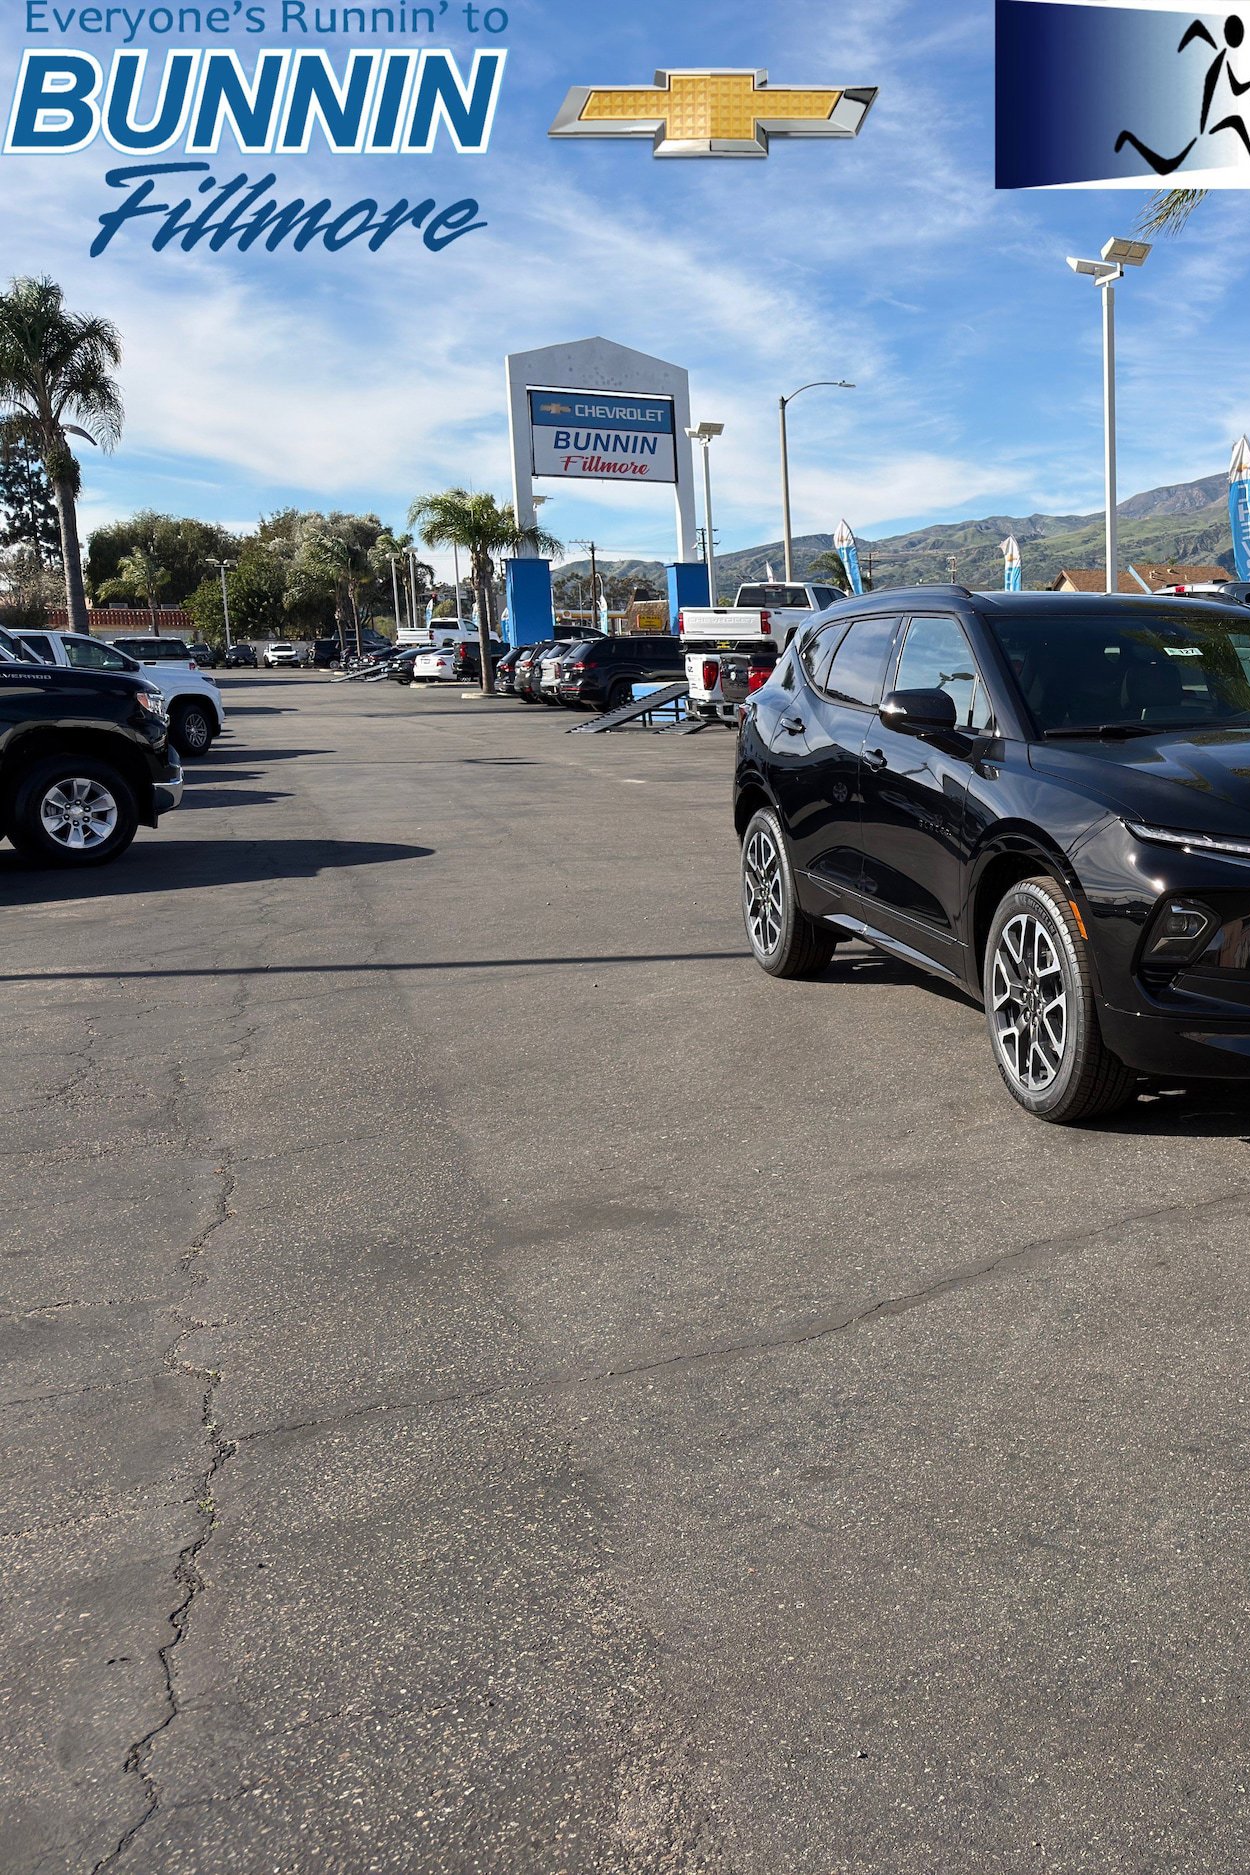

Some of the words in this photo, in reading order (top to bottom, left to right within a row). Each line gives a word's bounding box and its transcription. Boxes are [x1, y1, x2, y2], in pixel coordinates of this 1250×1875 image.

[575, 404, 664, 422] CHEVROLET
[553, 430, 658, 455] BUNNIN
[559, 455, 650, 476] Fillmore
